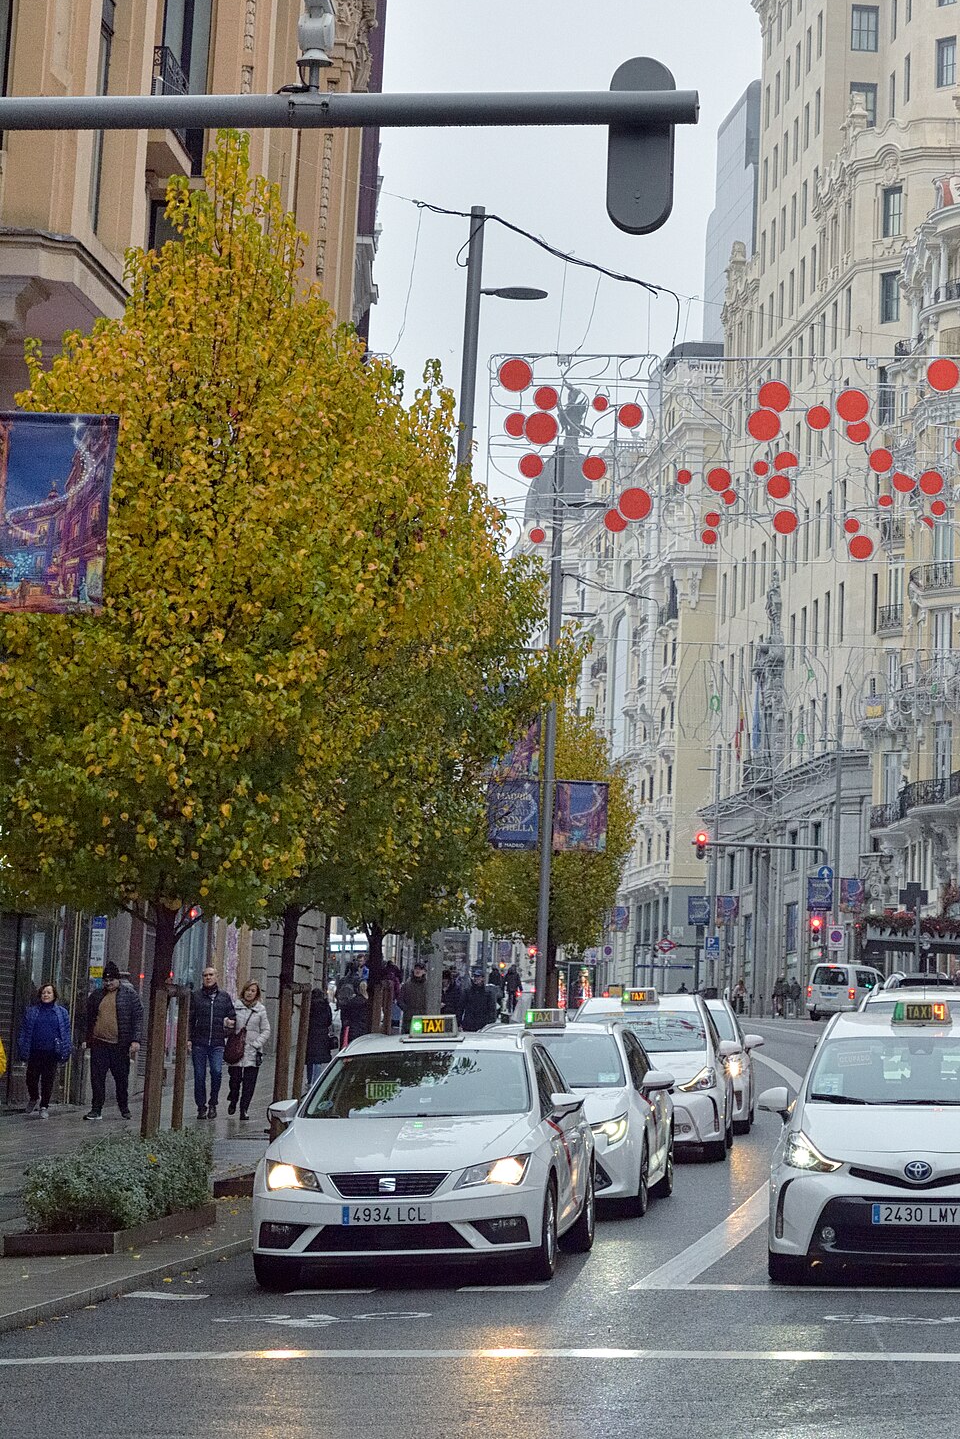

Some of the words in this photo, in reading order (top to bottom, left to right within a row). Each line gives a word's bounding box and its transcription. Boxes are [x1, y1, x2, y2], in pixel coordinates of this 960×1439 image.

[630, 992, 646, 1002] TAXI
[533, 1012, 552, 1023] TAXI
[907, 1005, 931, 1020] TAXI
[934, 1004, 945, 1020] 4
[422, 1019, 445, 1034] TAXI
[353, 1207, 392, 1222] 4934
[397, 1207, 427, 1222] LCL
[884, 1207, 923, 1222] 2430
[929, 1208, 958, 1223] LMY
